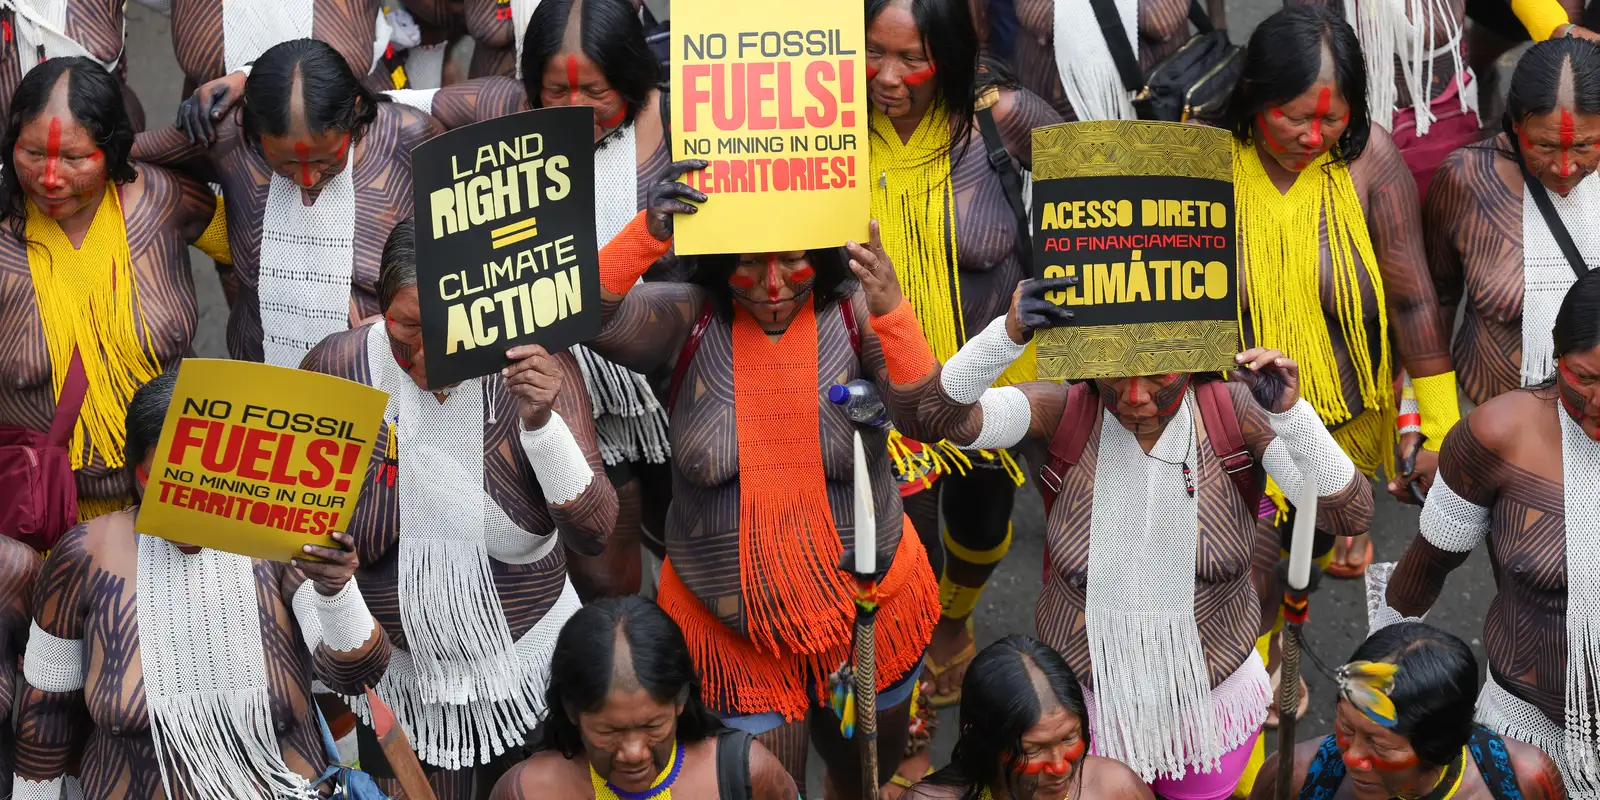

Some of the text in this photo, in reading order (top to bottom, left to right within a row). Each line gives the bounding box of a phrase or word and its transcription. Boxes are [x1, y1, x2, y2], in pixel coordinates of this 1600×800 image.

[683, 29, 856, 60] NO FOSSIL
[682, 59, 856, 132] FUELS!
[451, 132, 544, 180] LAND
[684, 134, 857, 155] NO MINING IN OUR
[430, 154, 571, 240] RIGHTS
[1041, 199, 1227, 230] ACESSO DIRETO
[490, 217, 538, 249] =
[1044, 234, 1226, 252] AO FINANCIAMENTO
[438, 234, 577, 301] CLIMATE
[1043, 249, 1228, 306] CLIMÁTICO
[446, 265, 582, 355] ACTION
[182, 397, 366, 443] NO FOSSIL
[167, 417, 362, 493] FUELS!
[158, 481, 340, 536] TERRITORIES!
[163, 467, 346, 508] NO MINING IN OUR
